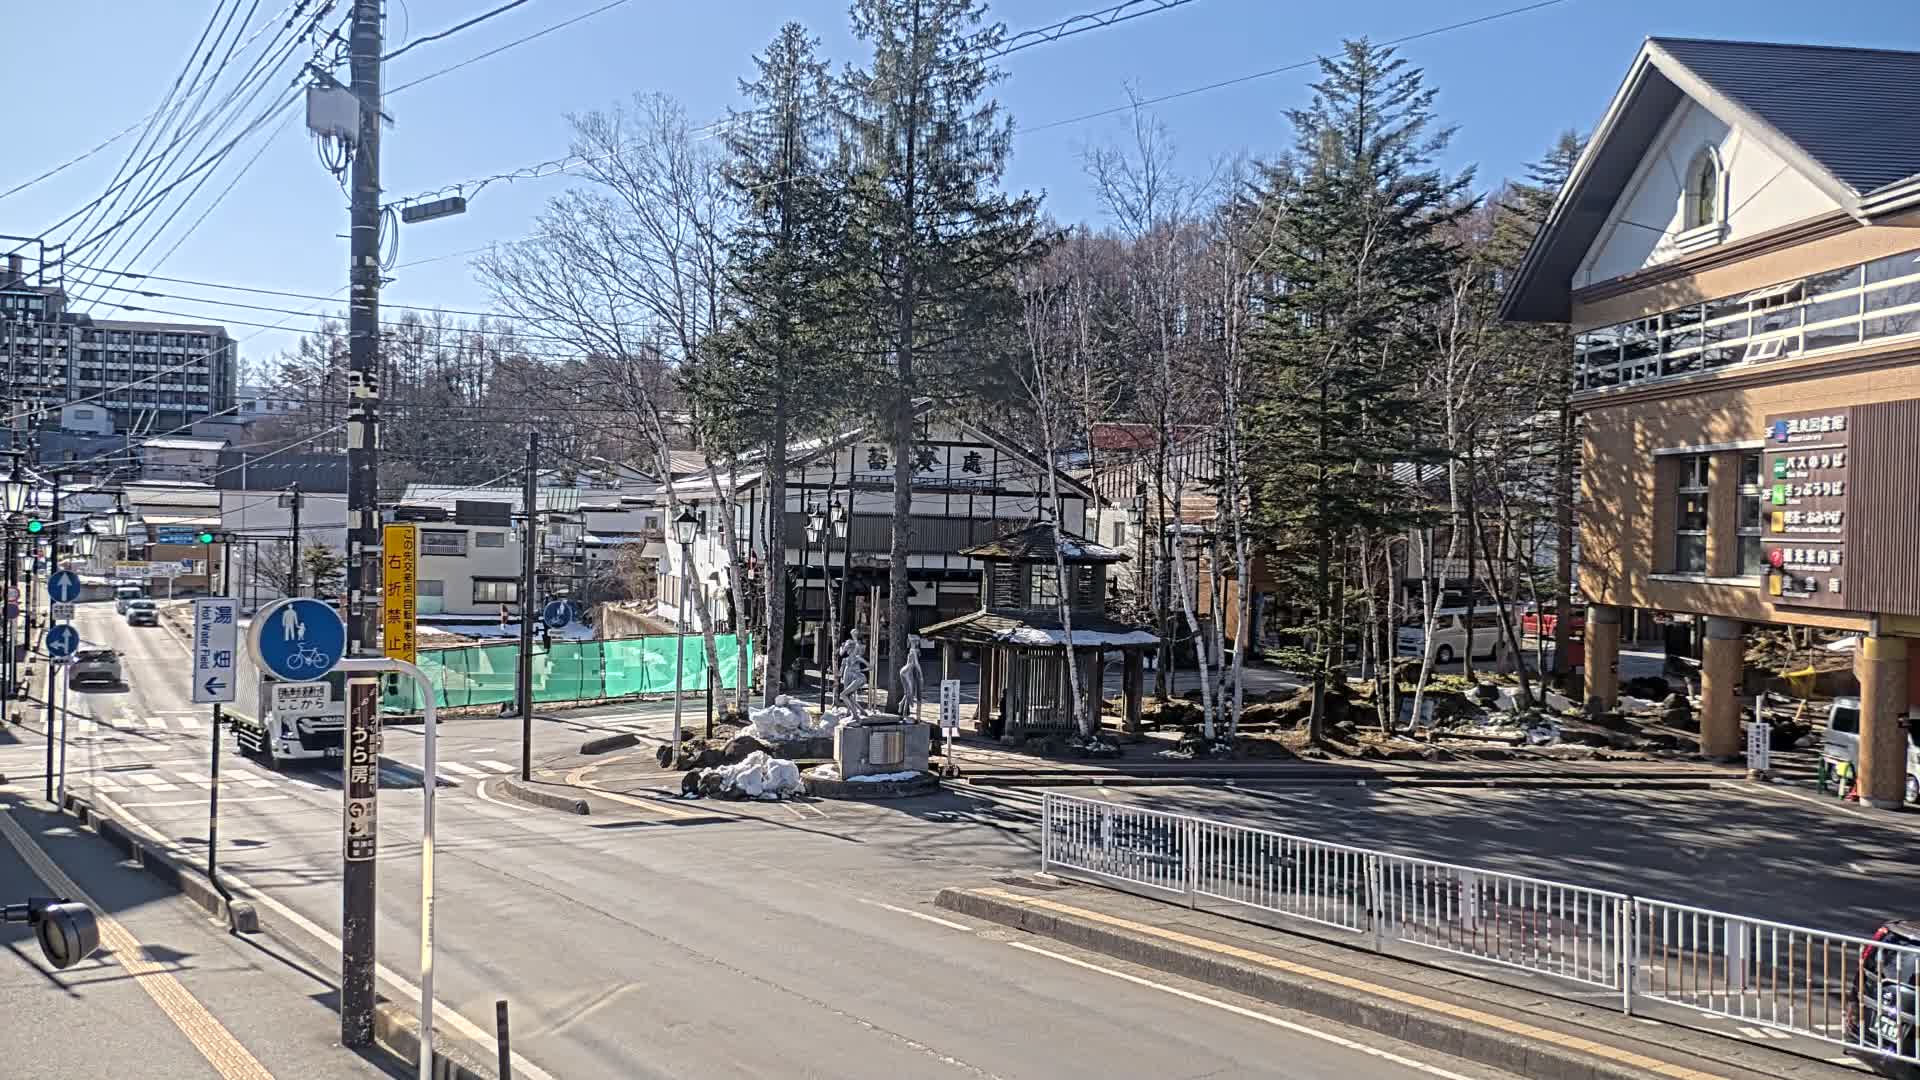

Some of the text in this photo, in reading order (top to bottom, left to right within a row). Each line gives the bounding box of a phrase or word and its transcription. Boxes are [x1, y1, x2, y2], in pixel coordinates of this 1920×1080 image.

[1784, 481, 1842, 496] きっぷうりば
[1786, 453, 1844, 468] バスのりば
[387, 554, 402, 650] 右折禁止
[199, 606, 211, 669] Hot Water Field
[213, 606, 232, 668] 湯畑
[278, 698, 324, 710] ここから
[352, 726, 369, 783] うら房
